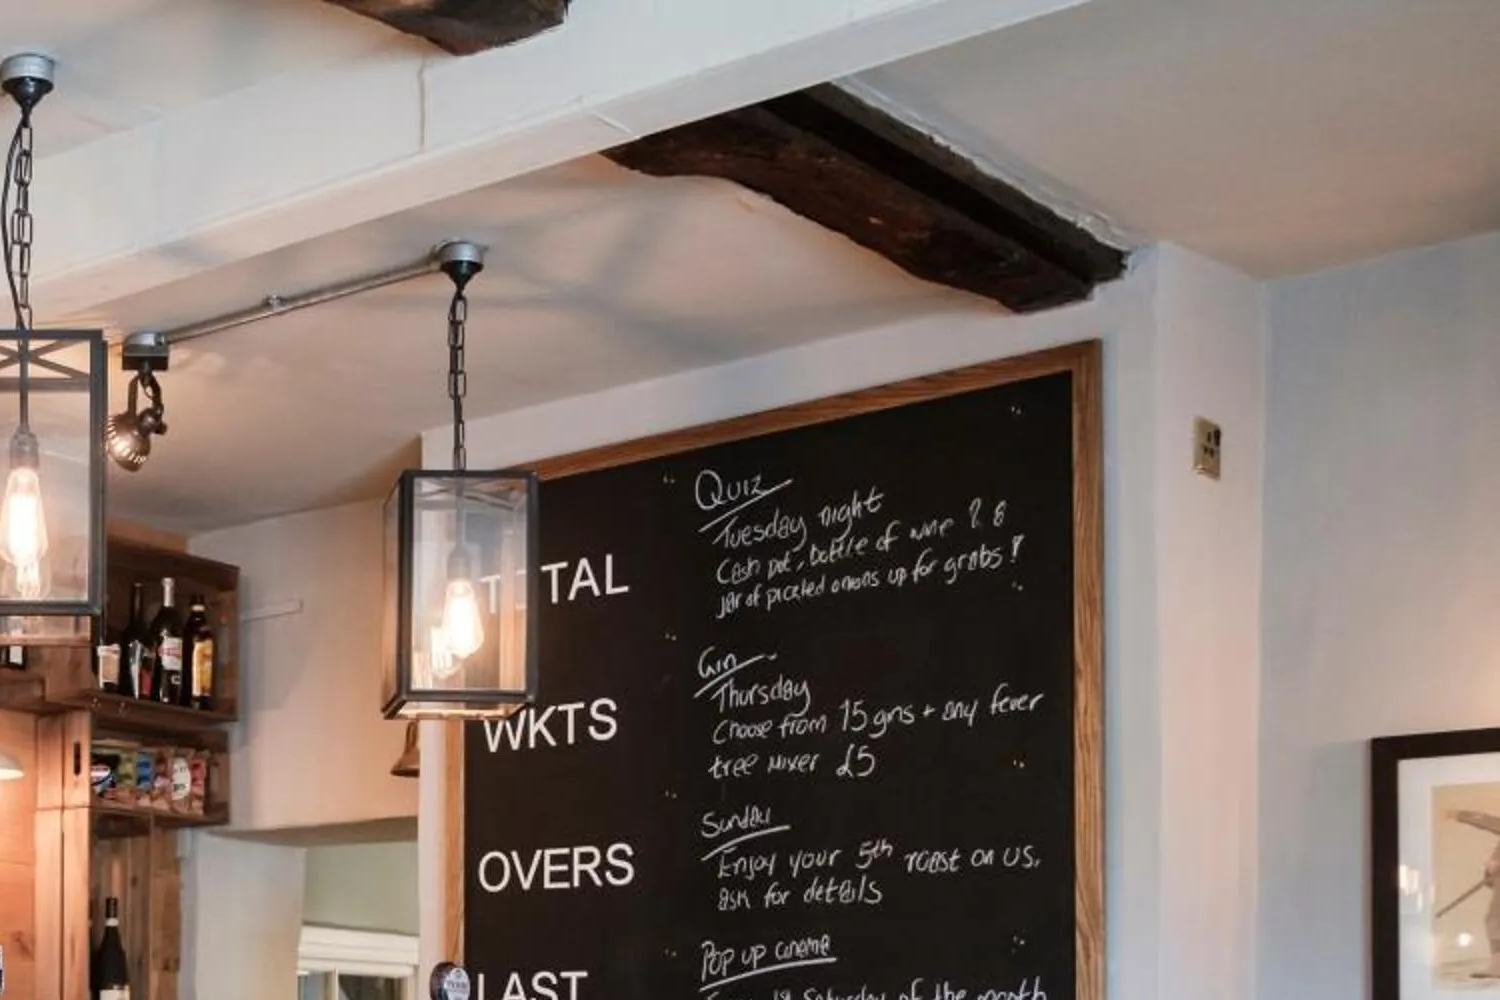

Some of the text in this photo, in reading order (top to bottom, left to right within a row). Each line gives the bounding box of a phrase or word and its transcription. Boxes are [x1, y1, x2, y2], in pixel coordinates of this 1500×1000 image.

[695, 469, 769, 511] Quiz
[712, 486, 885, 552] Tuesday night
[716, 557, 762, 585] Cash
[875, 520, 901, 551] of
[480, 553, 631, 614] TTAL
[716, 589, 741, 619] jar
[745, 584, 762, 607] of
[888, 566, 907, 585] up
[913, 547, 939, 582] for
[698, 646, 737, 679] Gin
[710, 674, 812, 717] Thursday
[712, 719, 772, 745] Choose
[778, 714, 828, 740] from
[839, 699, 868, 732] 15
[941, 699, 979, 728] any
[989, 683, 1045, 716] fever
[483, 698, 618, 753] WKTS
[707, 752, 760, 779] tree
[835, 743, 877, 778] £5
[478, 842, 636, 893] OVERS
[717, 846, 778, 882] Enjoy
[789, 849, 843, 880] your
[855, 838, 894, 871] 5th
[904, 849, 962, 874] roast
[971, 849, 994, 867] on
[763, 881, 792, 909] for
[803, 874, 885, 906] details
[700, 940, 735, 984] Pop
[741, 943, 767, 970] up
